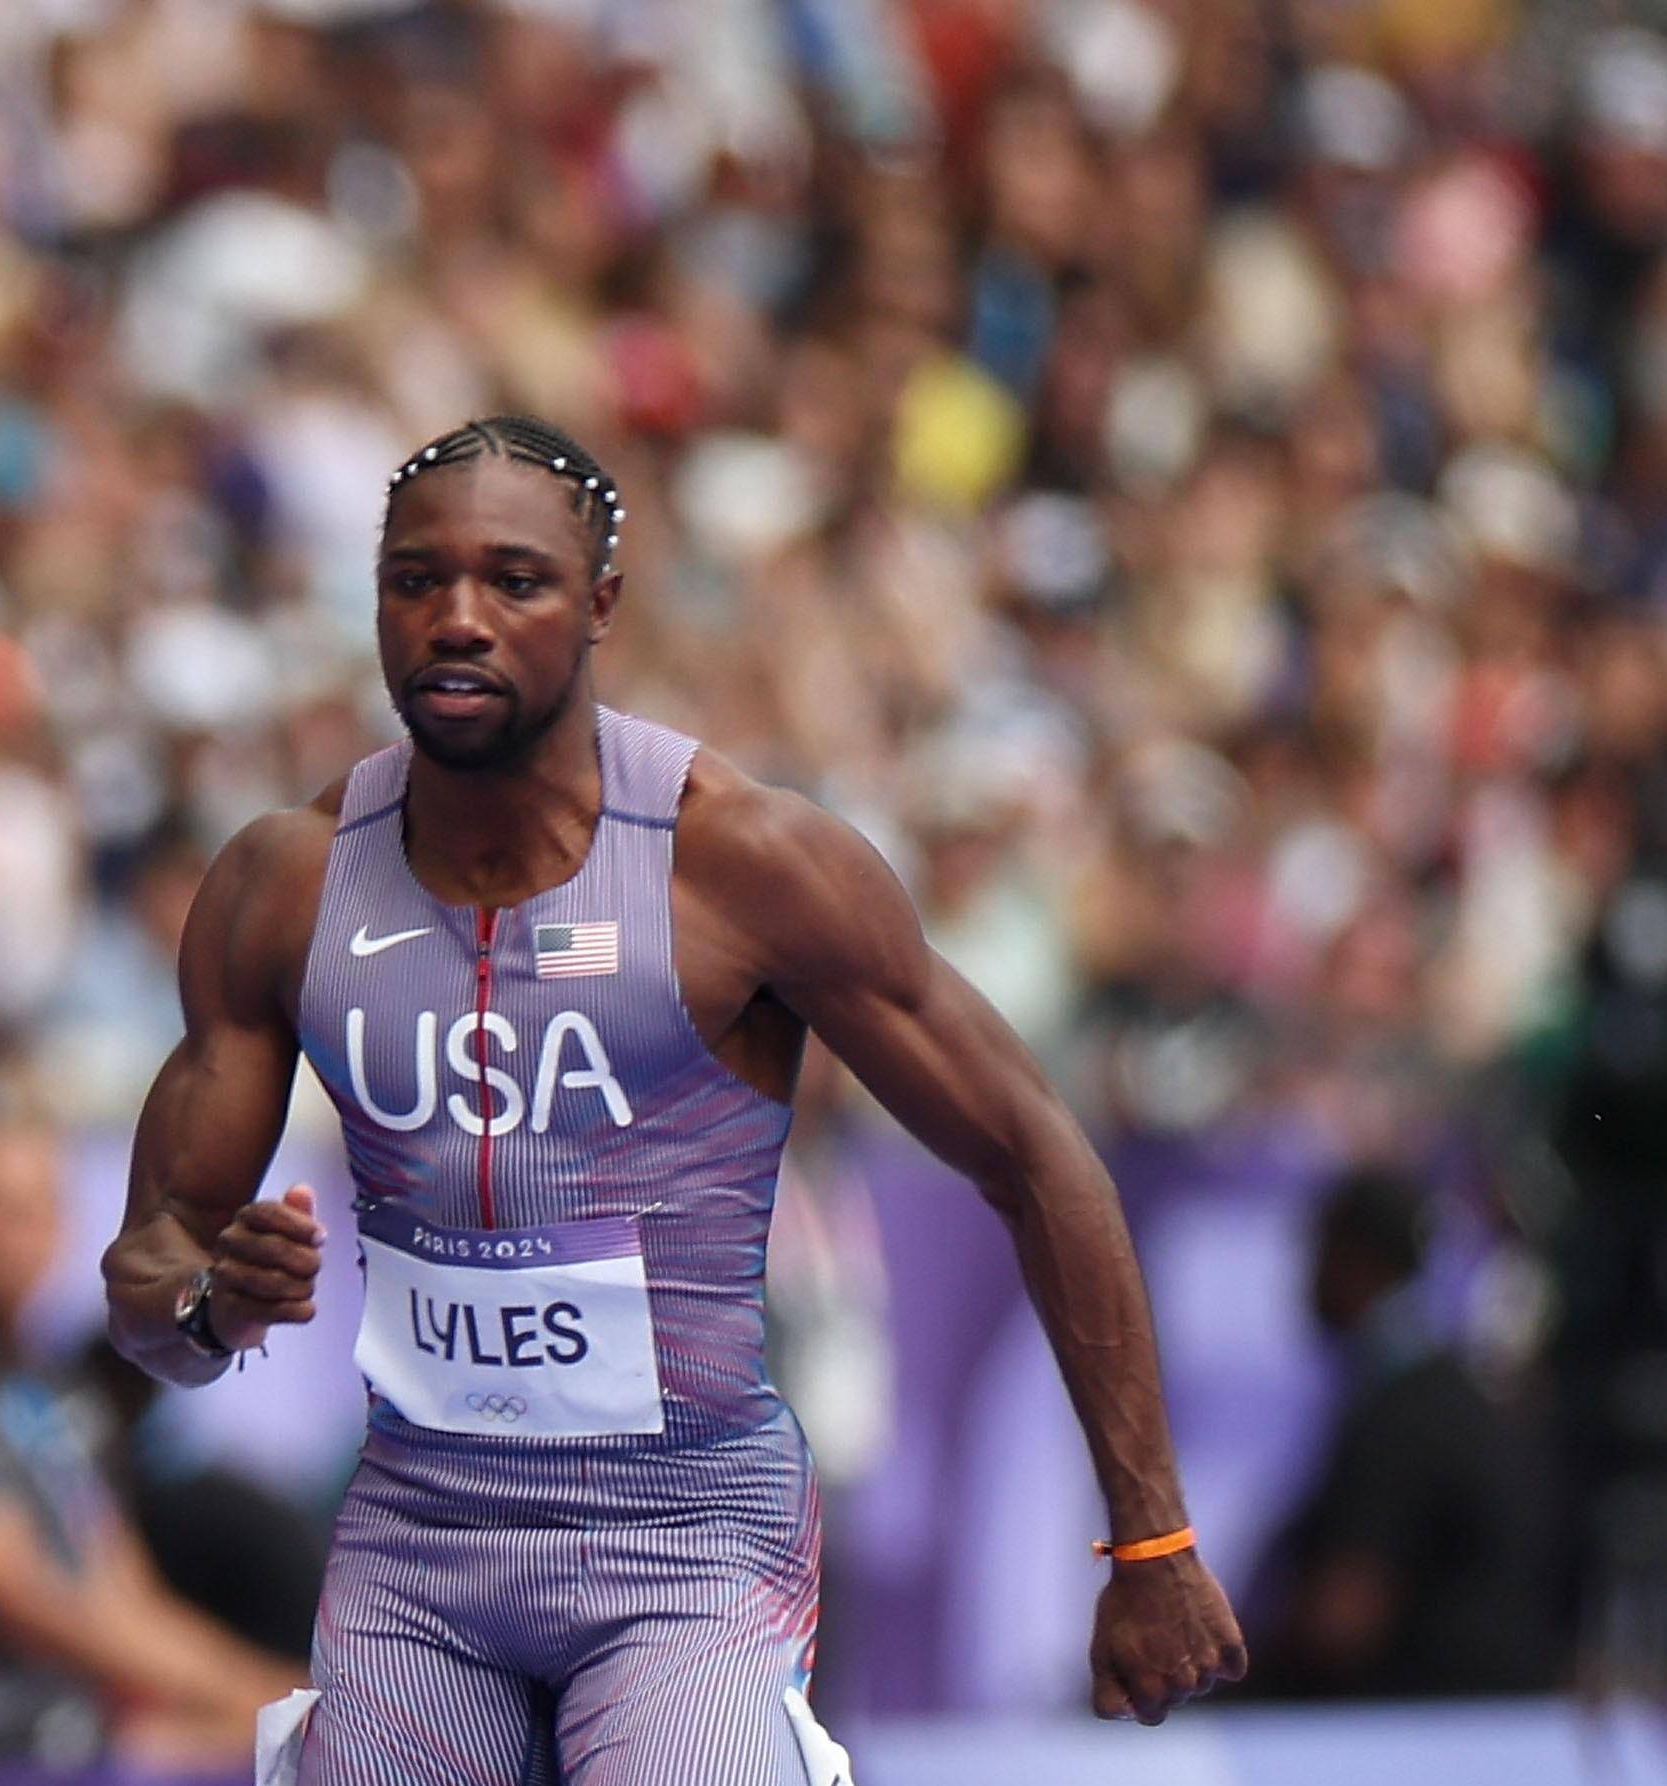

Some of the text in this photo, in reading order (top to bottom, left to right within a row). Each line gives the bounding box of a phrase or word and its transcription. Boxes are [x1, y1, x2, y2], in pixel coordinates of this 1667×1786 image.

[347, 1007, 633, 1136] USA
[413, 1226, 552, 1259] PARIS 2024
[410, 1287, 589, 1366] LYLES
